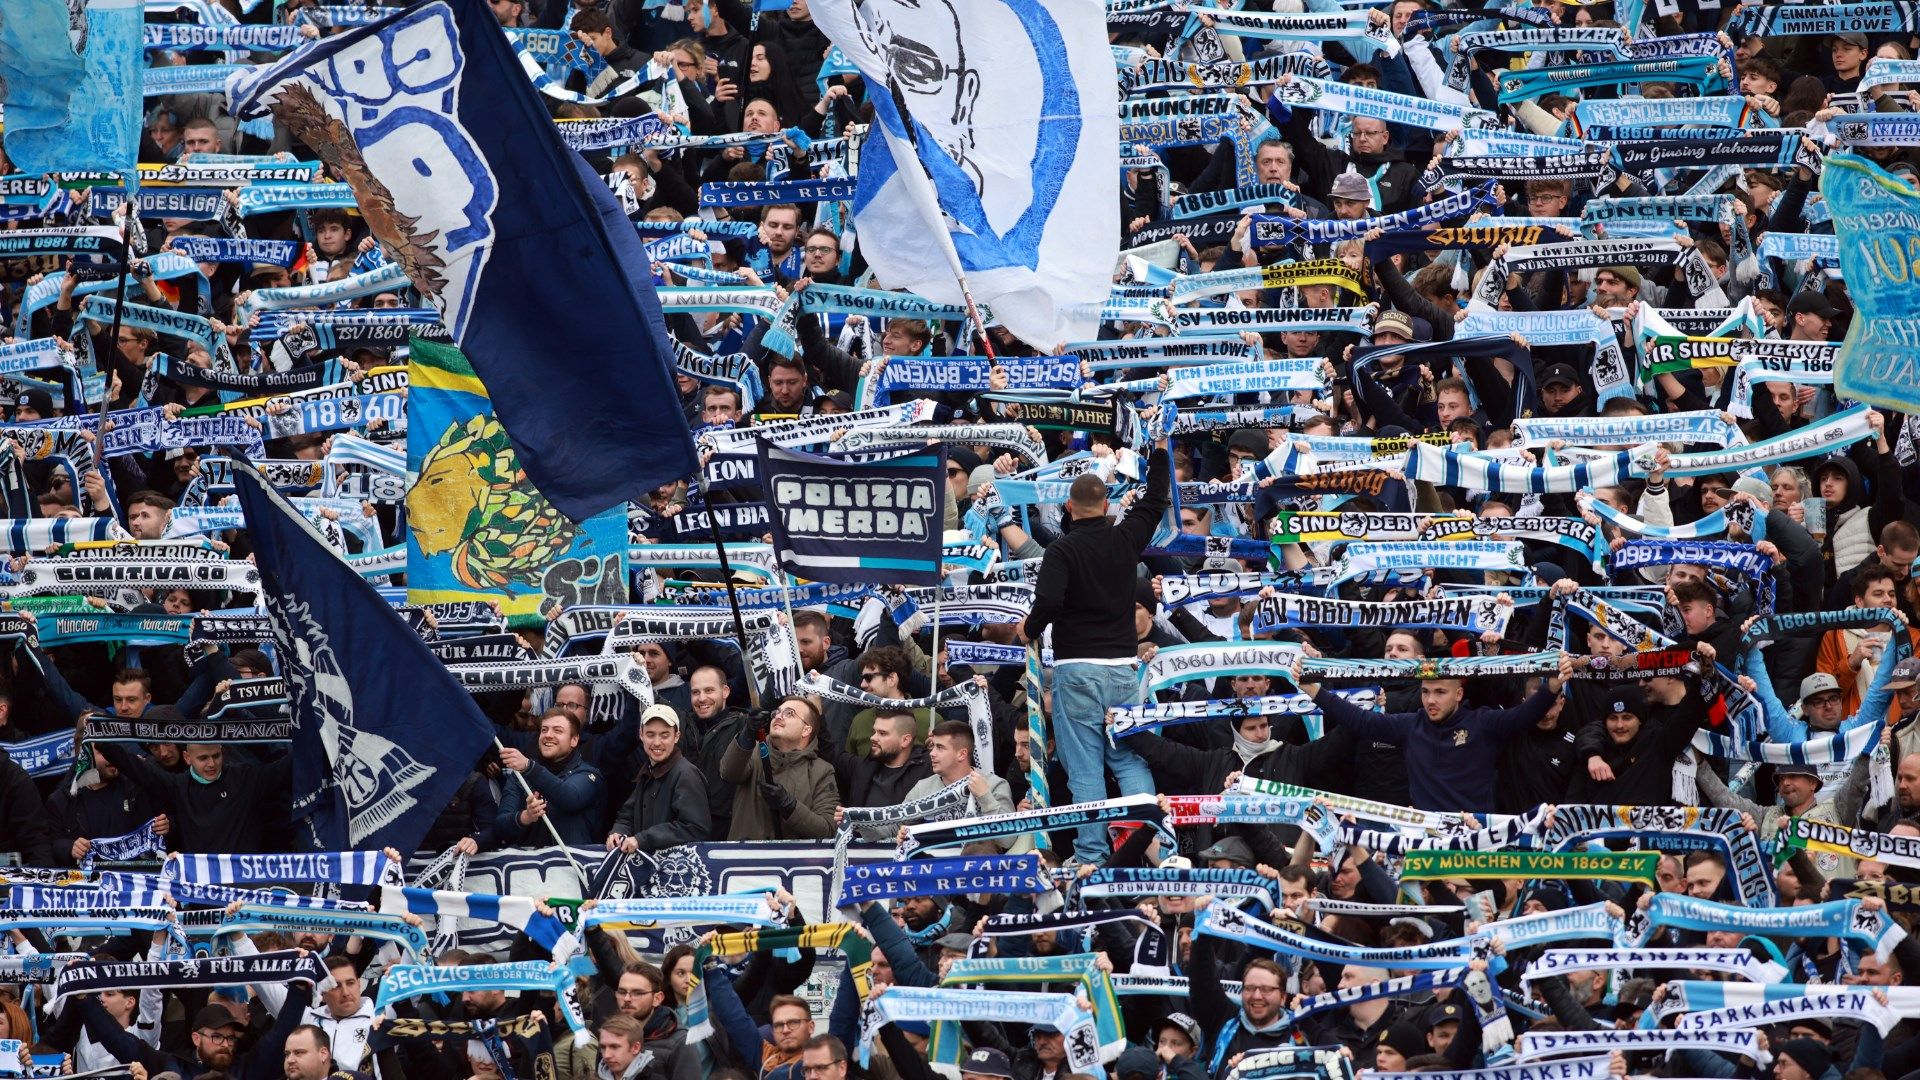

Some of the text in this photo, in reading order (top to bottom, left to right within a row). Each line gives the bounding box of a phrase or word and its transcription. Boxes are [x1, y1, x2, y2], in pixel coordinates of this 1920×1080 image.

[1781, 3, 1893, 20] EINMAL LÖWE
[1226, 15, 1264, 28] 1860
[1783, 16, 1891, 32] IMMER LÖWE
[170, 27, 217, 46] 1860
[1325, 83, 1341, 97] ICH
[1407, 97, 1463, 119] DIESE
[1345, 101, 1440, 127] LIEBE NICHT
[703, 189, 781, 205] GEGEN
[1177, 190, 1228, 215] 1860
[1417, 189, 1474, 223] 1860
[35, 236, 104, 251] TSV 1860
[184, 241, 221, 258] 1860
[1533, 242, 1655, 258] LÖWENINVASION
[1596, 253, 1670, 266] 24.02.2018
[835, 292, 875, 310] 1860
[1179, 310, 1252, 327] SV 1860
[339, 323, 403, 342] TSV 1860
[1110, 342, 1250, 361] LÖWE IMMER LÖWE
[1677, 341, 1731, 359] SIND
[888, 363, 958, 385] BAYERN
[1175, 366, 1202, 380] ICH
[1260, 358, 1315, 374] DIESE
[1757, 356, 1792, 374] TSV
[362, 374, 408, 395] SIND
[1197, 375, 1292, 392] LIEBE NICHT
[303, 394, 402, 429] 18 60
[1024, 403, 1047, 419] 150
[776, 481, 932, 510] POLIZIA
[674, 505, 770, 534] LEONI BIA
[788, 508, 924, 536] MERDA
[1288, 515, 1412, 535] SIND DER
[1426, 521, 1472, 542] SIND
[1375, 553, 1480, 569] LIEBE NICHT
[1616, 545, 1664, 567] 1860
[56, 565, 192, 581] COMITIVA
[819, 583, 867, 599] 1860
[1161, 573, 1263, 606] BLUE
[1257, 597, 1474, 630] TSV 1860 MÜNCHEN
[1773, 611, 1817, 633] 1860
[56, 617, 100, 635] München
[613, 619, 738, 637] COMITIVA
[470, 644, 514, 661] ALLE
[1169, 651, 1216, 673] 1860
[1609, 671, 1624, 680] DEN
[238, 685, 263, 699] TSV
[135, 721, 217, 740] BLOOD
[1046, 811, 1090, 828] 1860
[1796, 821, 1920, 857] SIND DER
[241, 853, 331, 880] SECHZIG
[962, 858, 1029, 872] FANS
[1404, 853, 1645, 873] TSV MÜNCHEN VON 1860 E.V.
[935, 875, 1039, 892] RECHTS
[1123, 868, 1183, 883] 1860
[180, 883, 274, 906] SECHZIG
[1107, 880, 1261, 897] GRÜNWALDER STADION
[40, 889, 121, 910] SECHZIG
[1508, 918, 1551, 940] 1860
[1418, 942, 1462, 959] LÖWE
[101, 956, 294, 978] VEREIN FÜR ALLE
[474, 970, 523, 981] CLUB DER
[387, 963, 471, 993] SECHZIG
[1682, 993, 1867, 1031] ISARKANAKEN
